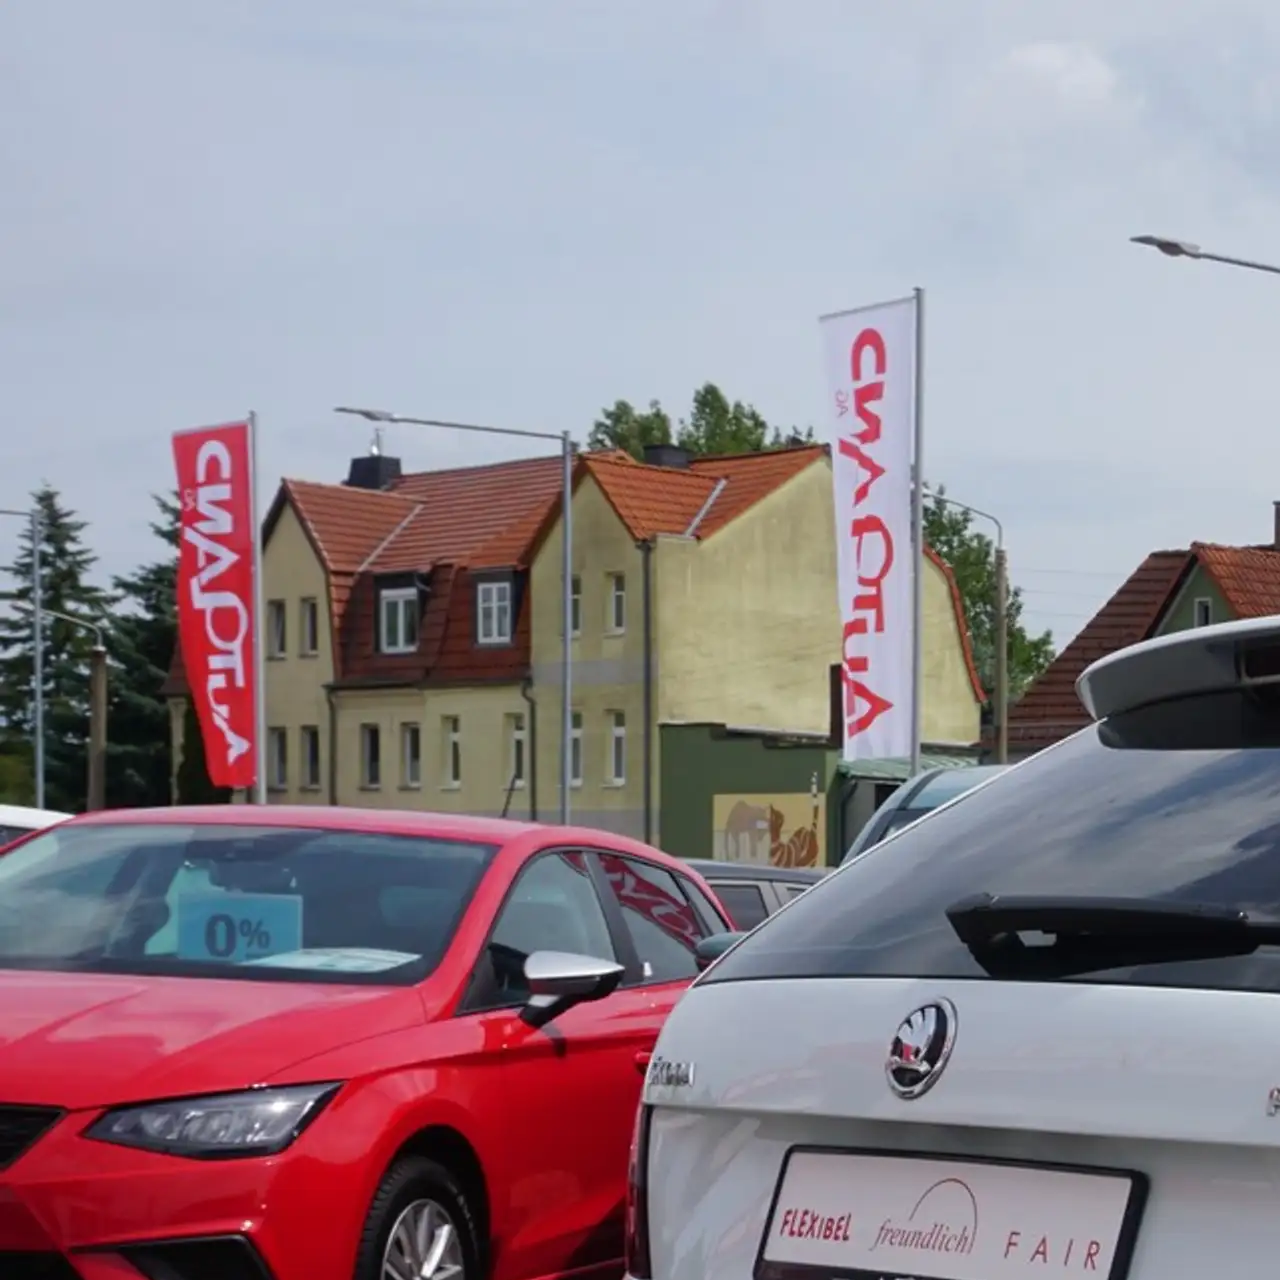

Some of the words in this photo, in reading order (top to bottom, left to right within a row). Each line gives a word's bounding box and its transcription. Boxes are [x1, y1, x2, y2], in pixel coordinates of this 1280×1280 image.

[204, 913, 271, 958] 0%
[779, 1208, 852, 1242] FLEXIBEL
[868, 1218, 974, 1256] freundlich
